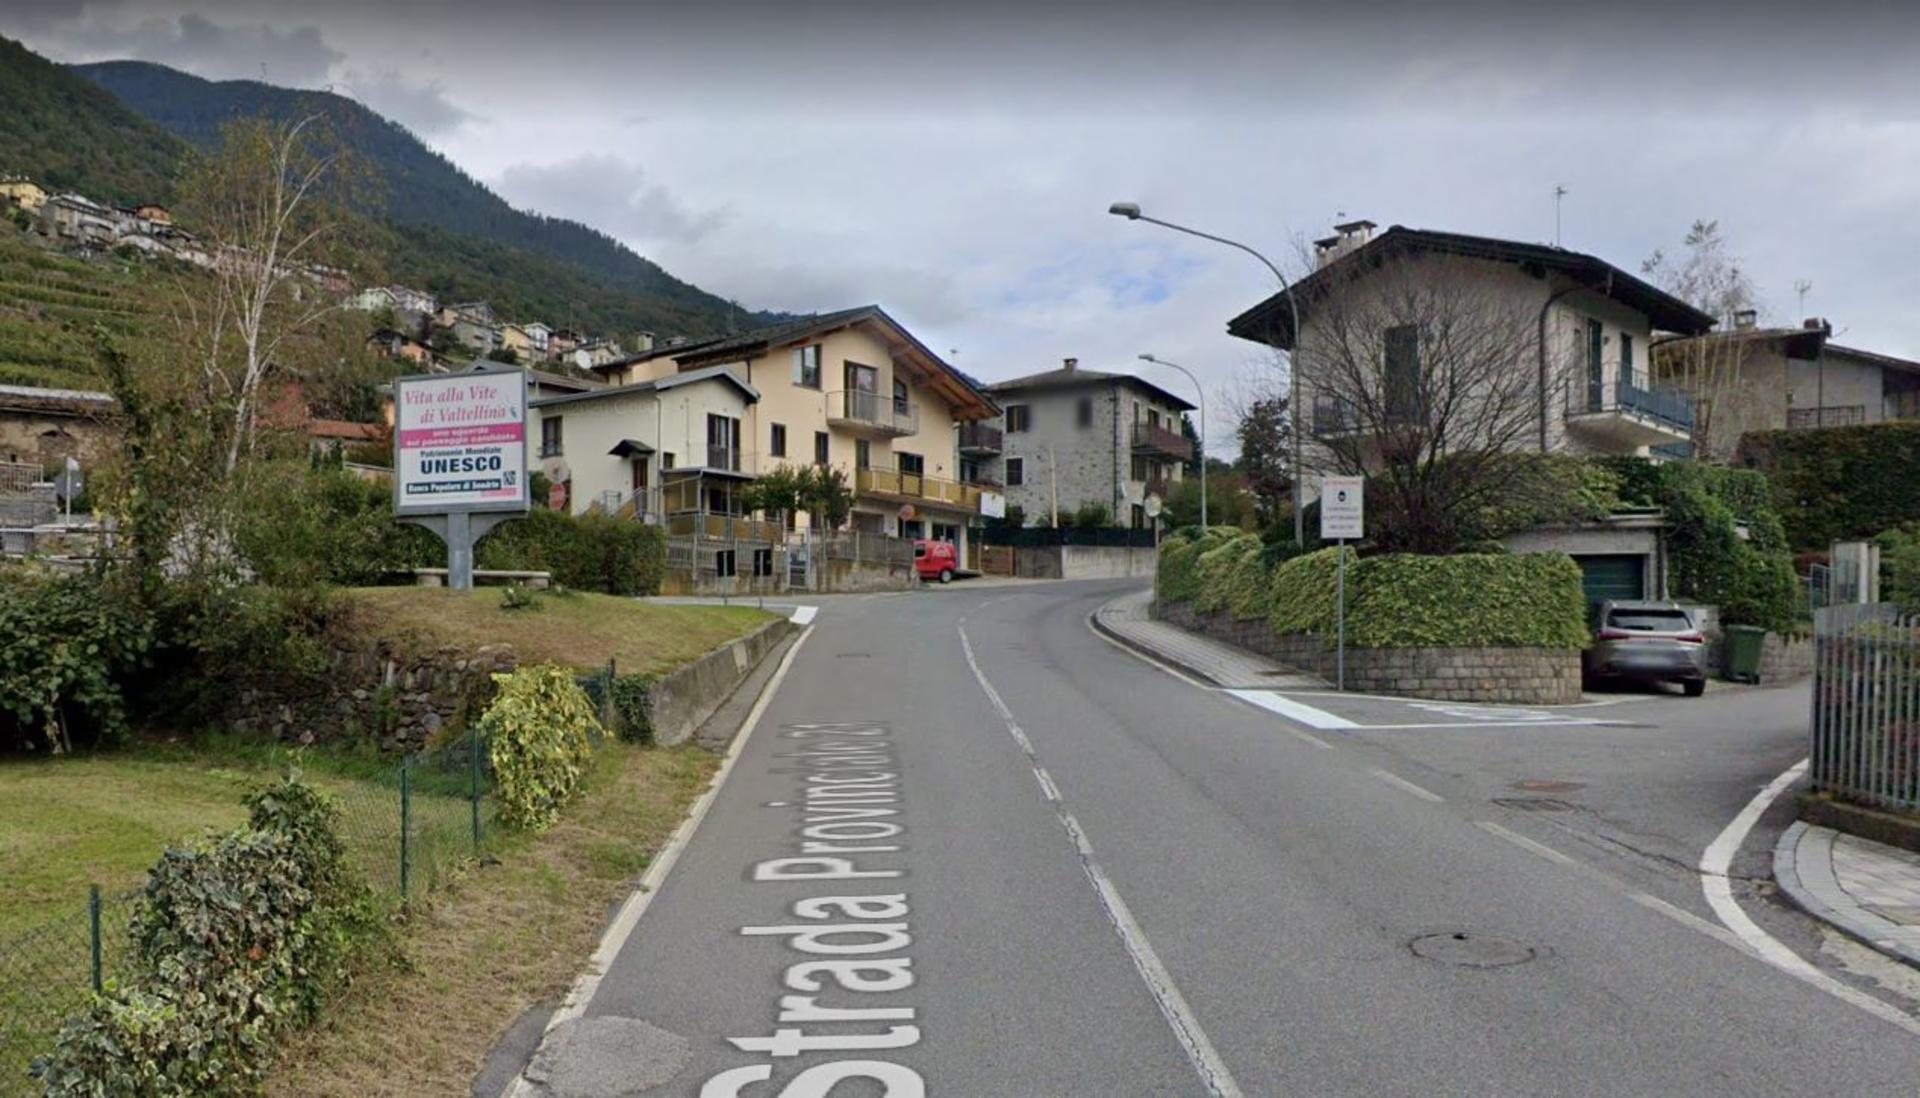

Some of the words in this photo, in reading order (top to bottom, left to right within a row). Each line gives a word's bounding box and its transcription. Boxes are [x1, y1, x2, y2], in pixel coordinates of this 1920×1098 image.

[405, 390, 433, 405] Vita
[437, 387, 464, 402] alla
[469, 385, 497, 400] Vite
[420, 408, 435, 423] di
[439, 404, 507, 422] Valtellina
[421, 456, 502, 475] UNESCO
